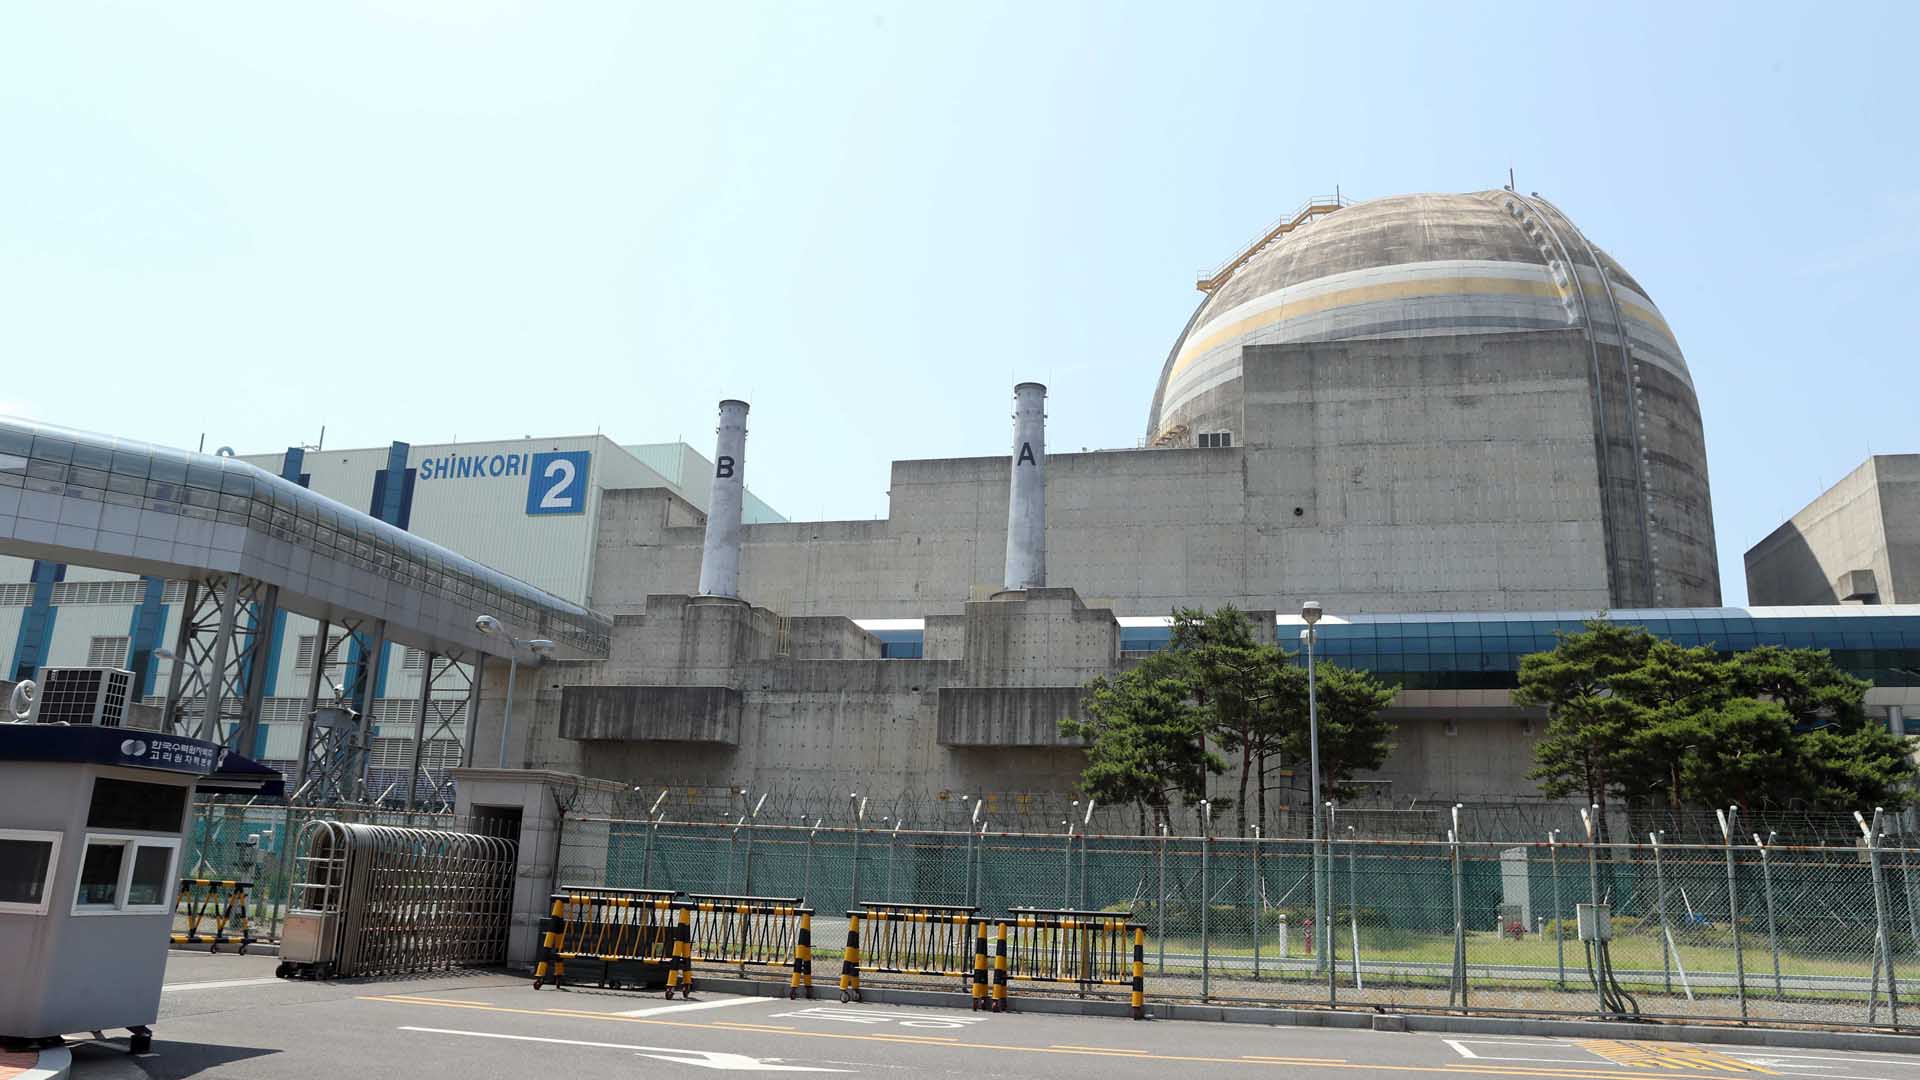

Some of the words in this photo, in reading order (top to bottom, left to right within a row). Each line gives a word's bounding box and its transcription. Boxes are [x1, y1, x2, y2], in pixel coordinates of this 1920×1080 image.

[1017, 442, 1036, 466] A
[716, 455, 735, 478] B
[420, 453, 528, 480] SHINKORI
[540, 459, 576, 508] 2
